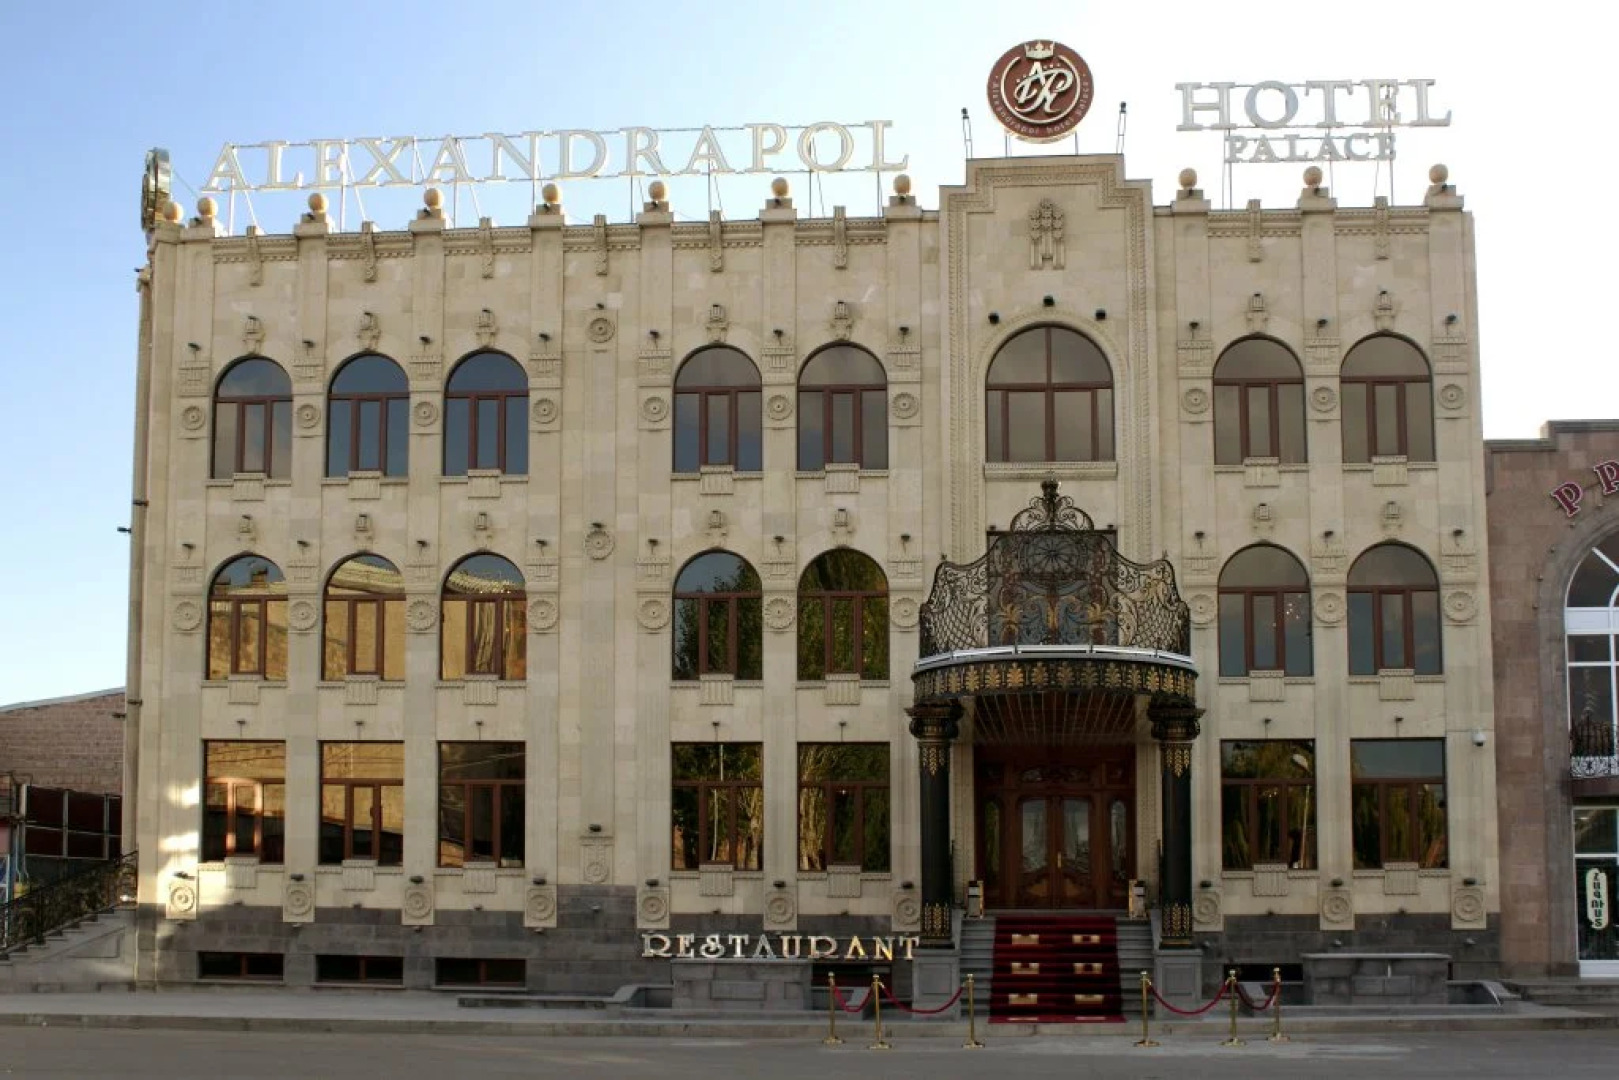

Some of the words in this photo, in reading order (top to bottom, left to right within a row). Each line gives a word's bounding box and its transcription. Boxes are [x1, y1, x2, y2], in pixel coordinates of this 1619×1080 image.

[1175, 79, 1452, 131] HOTEL
[201, 119, 909, 193] ALEXANDRAPOL
[1224, 133, 1397, 163] PALACE
[641, 933, 920, 961] RESTAURANT
